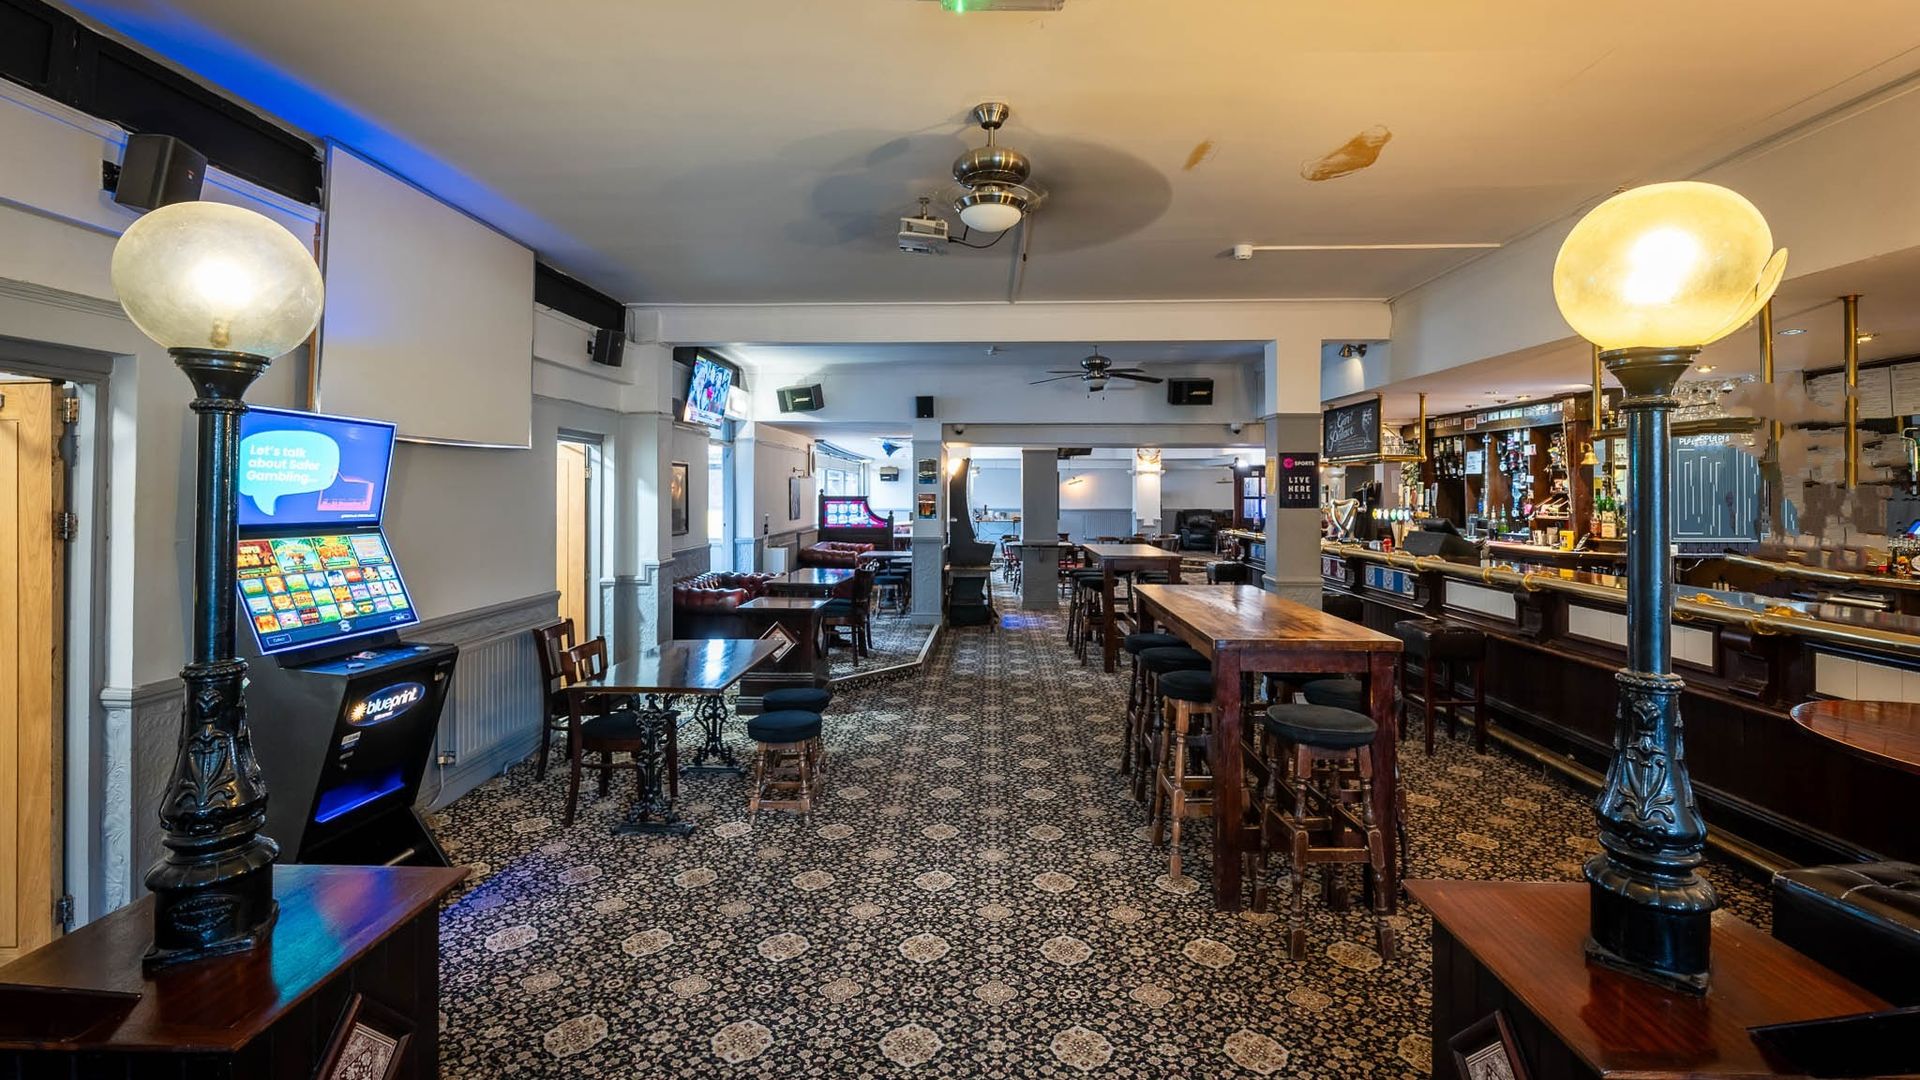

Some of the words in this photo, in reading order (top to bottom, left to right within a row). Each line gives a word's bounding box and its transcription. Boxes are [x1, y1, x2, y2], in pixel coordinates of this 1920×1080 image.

[249, 444, 280, 457] Let's
[283, 447, 306, 458] talk
[248, 457, 287, 469] about
[289, 459, 320, 471] Safer
[1289, 476, 1310, 484] LIVE
[1288, 485, 1311, 493] HERE
[367, 688, 417, 714] blueprint
